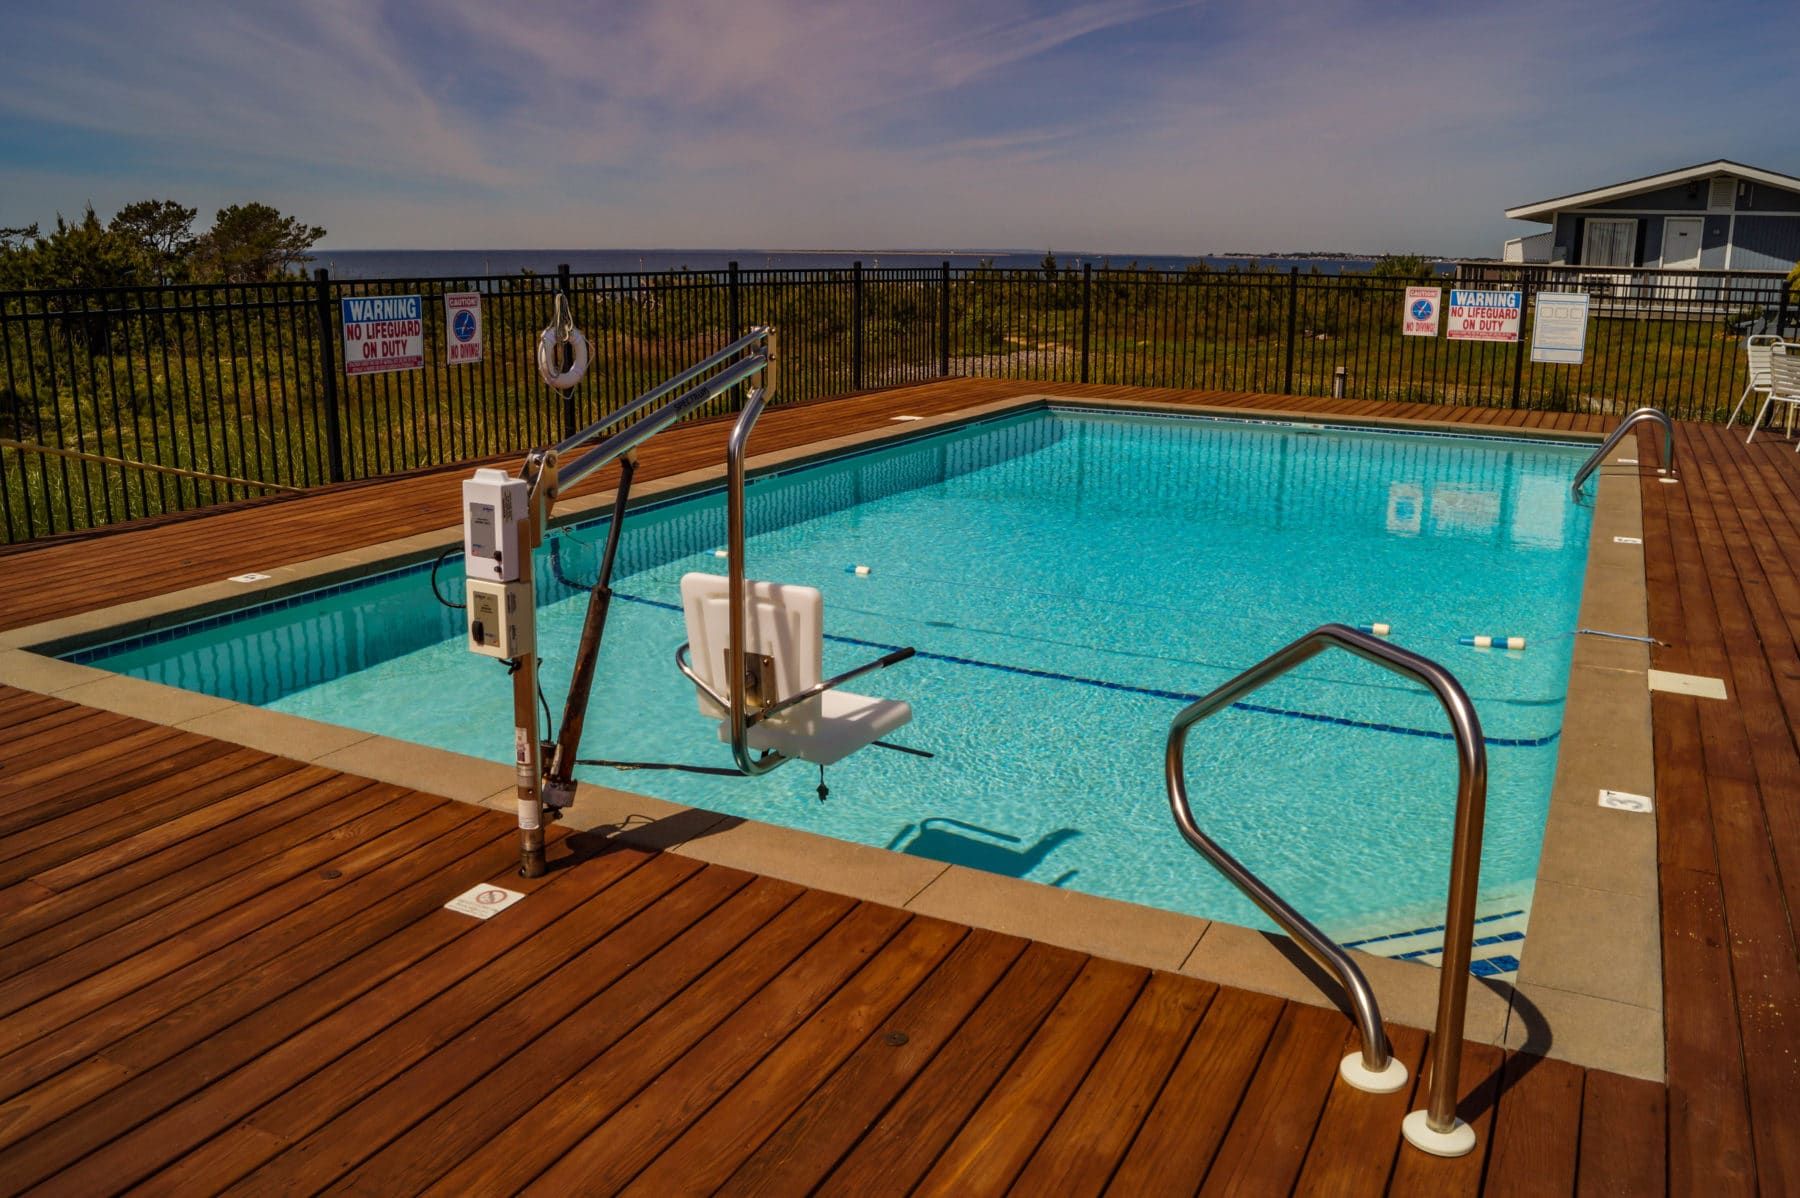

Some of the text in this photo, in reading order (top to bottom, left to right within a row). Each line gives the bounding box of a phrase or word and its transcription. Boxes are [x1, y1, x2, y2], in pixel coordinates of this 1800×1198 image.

[1456, 292, 1516, 308] WARNING
[349, 298, 416, 322] WARNING
[1451, 307, 1518, 320] NO LIFEGUARD
[347, 320, 420, 341] NO LIFEGUARD
[1405, 322, 1414, 332] NO
[1462, 320, 1504, 331] ON DUTY
[363, 340, 408, 359] ON DUTY
[450, 343, 480, 359] NO DIVING!
